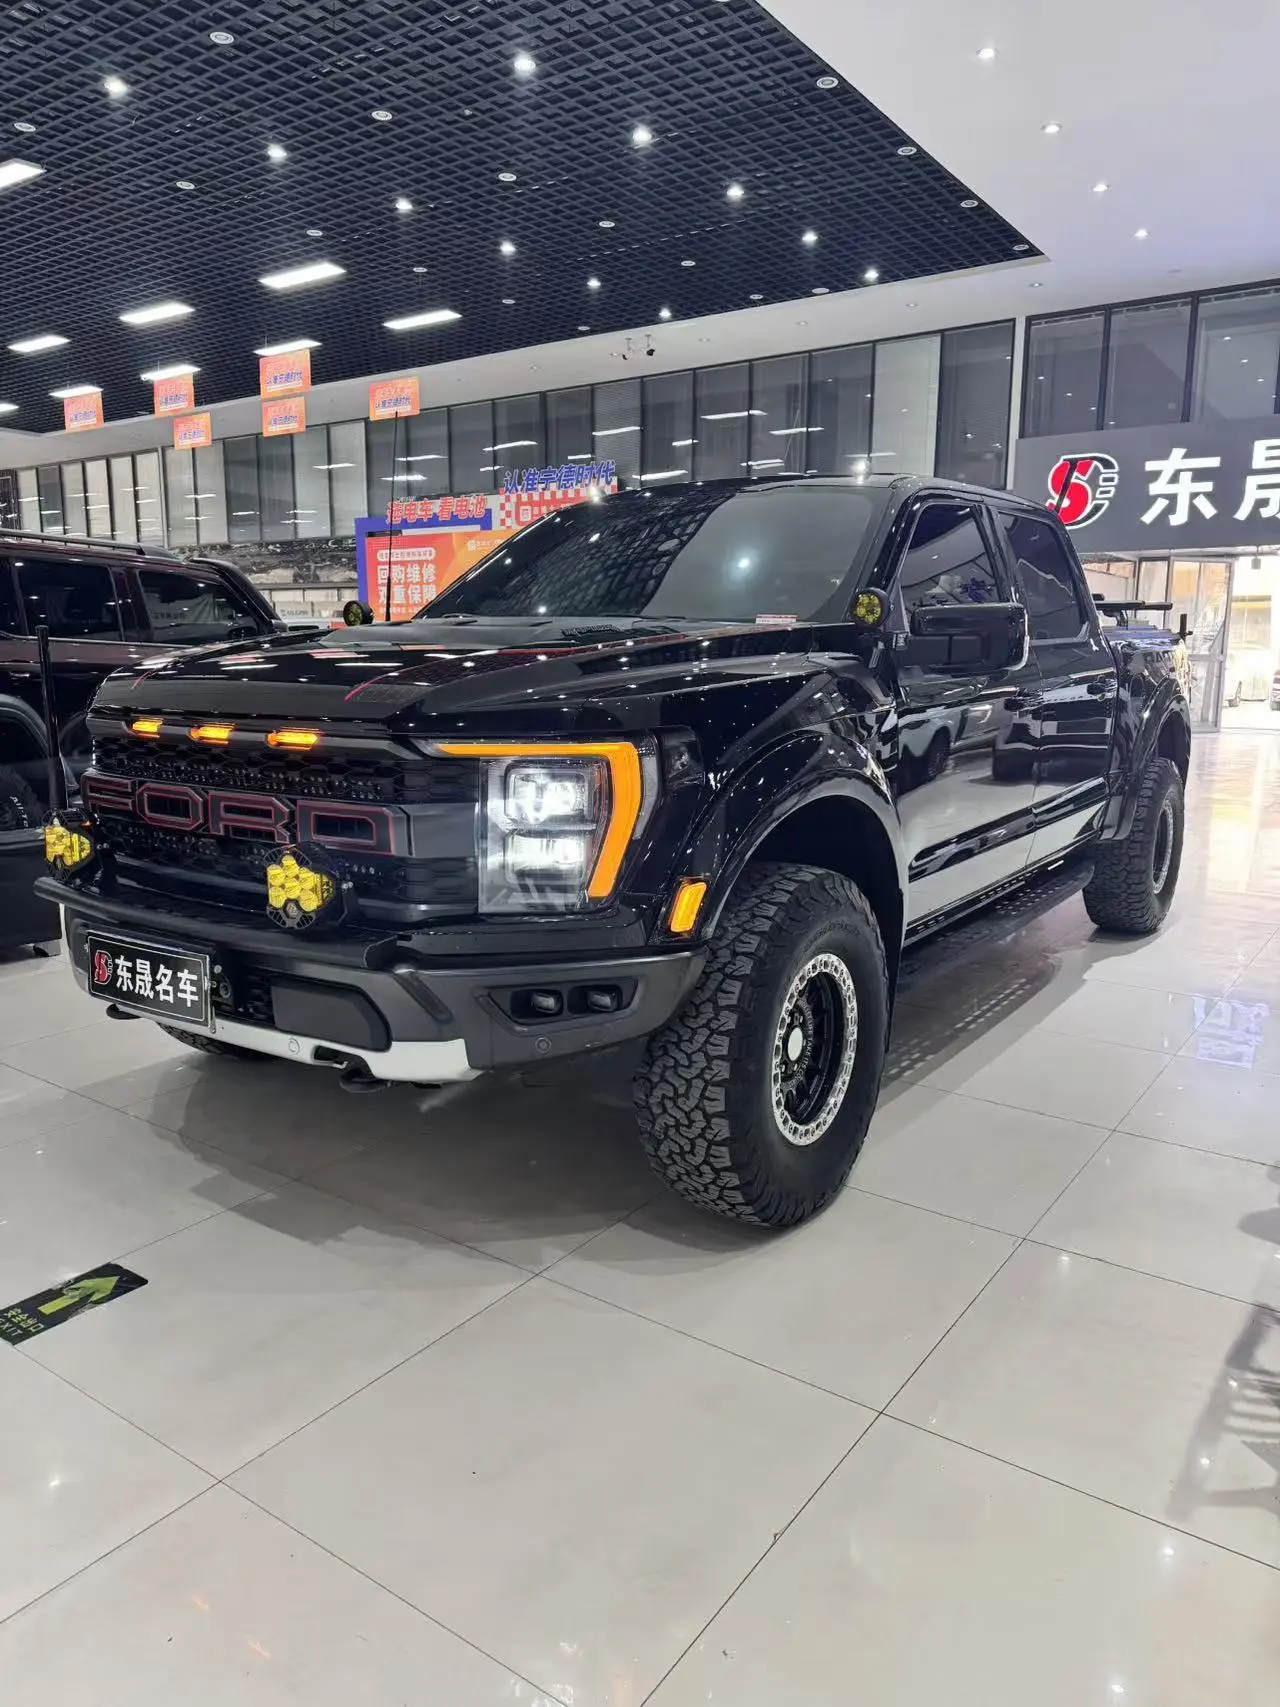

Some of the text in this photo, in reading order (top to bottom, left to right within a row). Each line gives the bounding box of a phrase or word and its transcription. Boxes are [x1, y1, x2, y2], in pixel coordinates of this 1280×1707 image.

[504, 459, 616, 495] 认准宁德时代
[82, 775, 396, 856] FORD
[115, 955, 199, 1008] 东晟名车
